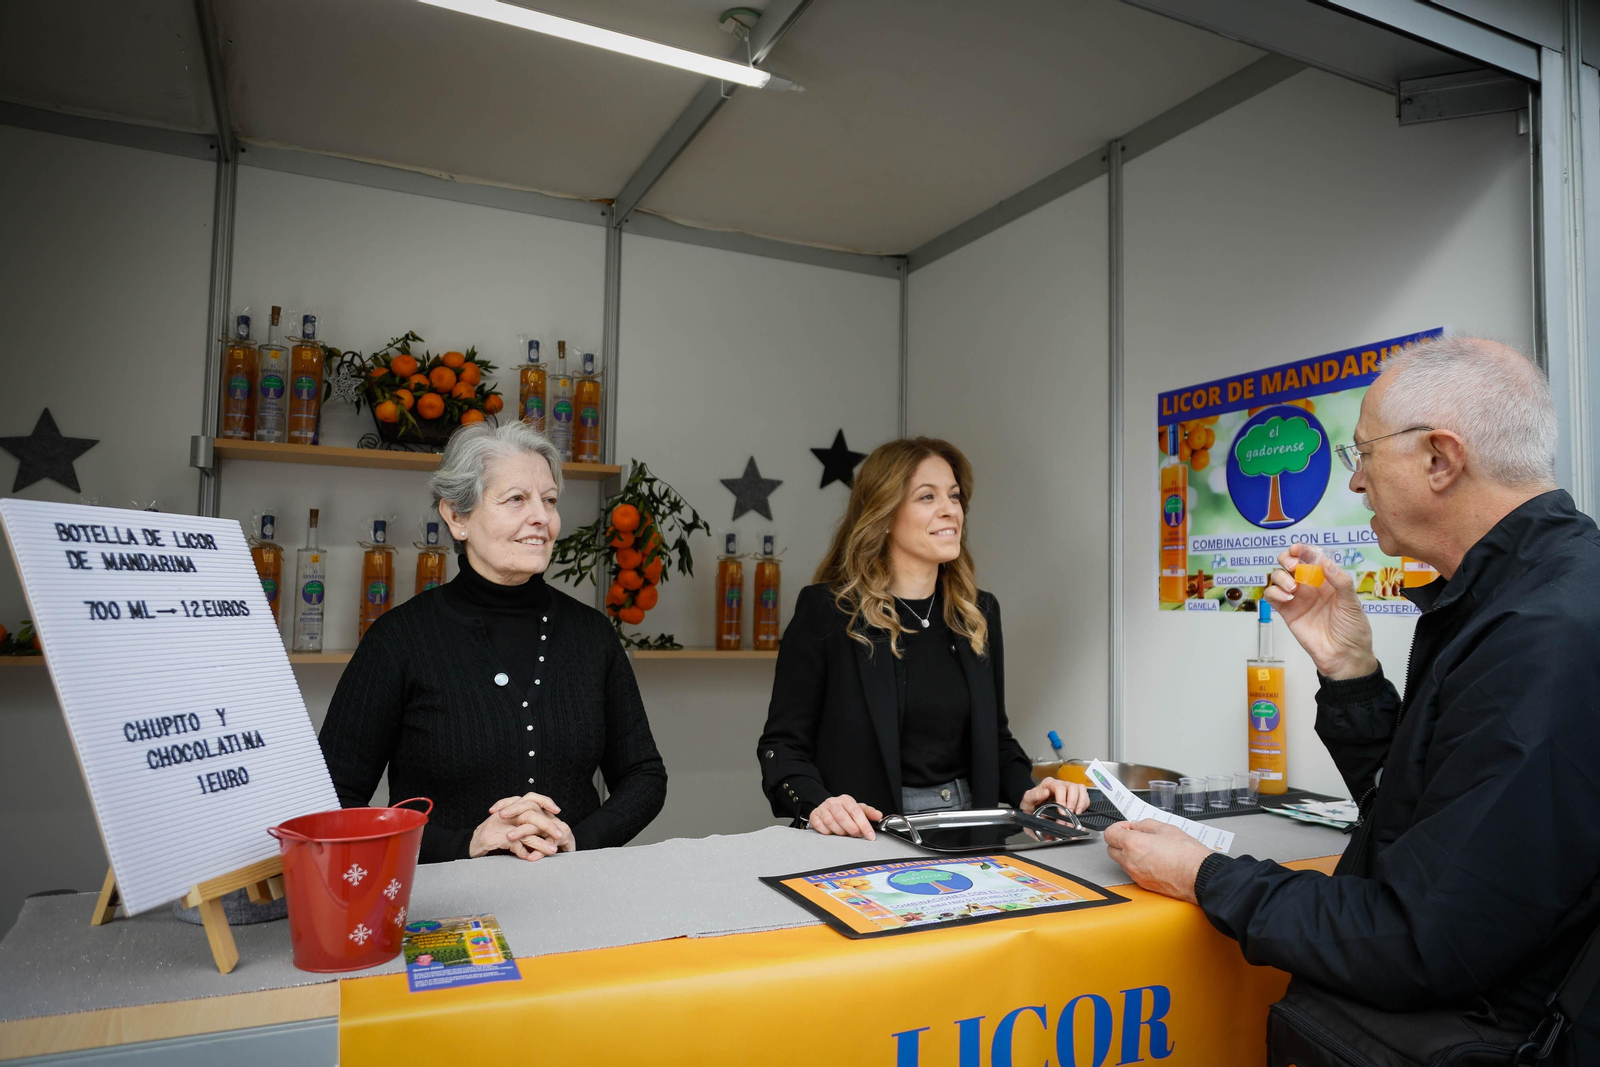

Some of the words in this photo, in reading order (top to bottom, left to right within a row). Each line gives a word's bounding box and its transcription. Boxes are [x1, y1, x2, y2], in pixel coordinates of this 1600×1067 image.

[1162, 385, 1222, 416] LICOR
[1227, 378, 1255, 402] DE
[1269, 425, 1279, 438] el
[1245, 441, 1305, 461] gadorense
[54, 522, 139, 546] BOTELLA
[141, 528, 166, 547] DE
[172, 530, 218, 550] LICOR
[1192, 534, 1287, 550] COMBINACIONES
[1291, 532, 1318, 547] CON
[1323, 531, 1341, 544] EL
[1348, 529, 1378, 542] LICO
[65, 549, 93, 570] DE
[100, 551, 198, 573] MANDARINA
[1230, 556, 1251, 566] BIEN
[1253, 555, 1275, 565] FRIO
[1216, 574, 1265, 586] CHOCOLATE
[83, 600, 121, 621] 700
[127, 599, 156, 619] ML
[1188, 601, 1217, 611] CANELA
[1362, 604, 1420, 614] EPOSTERIA
[123, 712, 201, 742] CHUPITO
[215, 708, 226, 727] Y
[147, 730, 266, 769] CHOCOLATINA
[808, 869, 862, 881] LICOR
[864, 865, 884, 873] DE
[888, 856, 987, 869] MANDARINA
